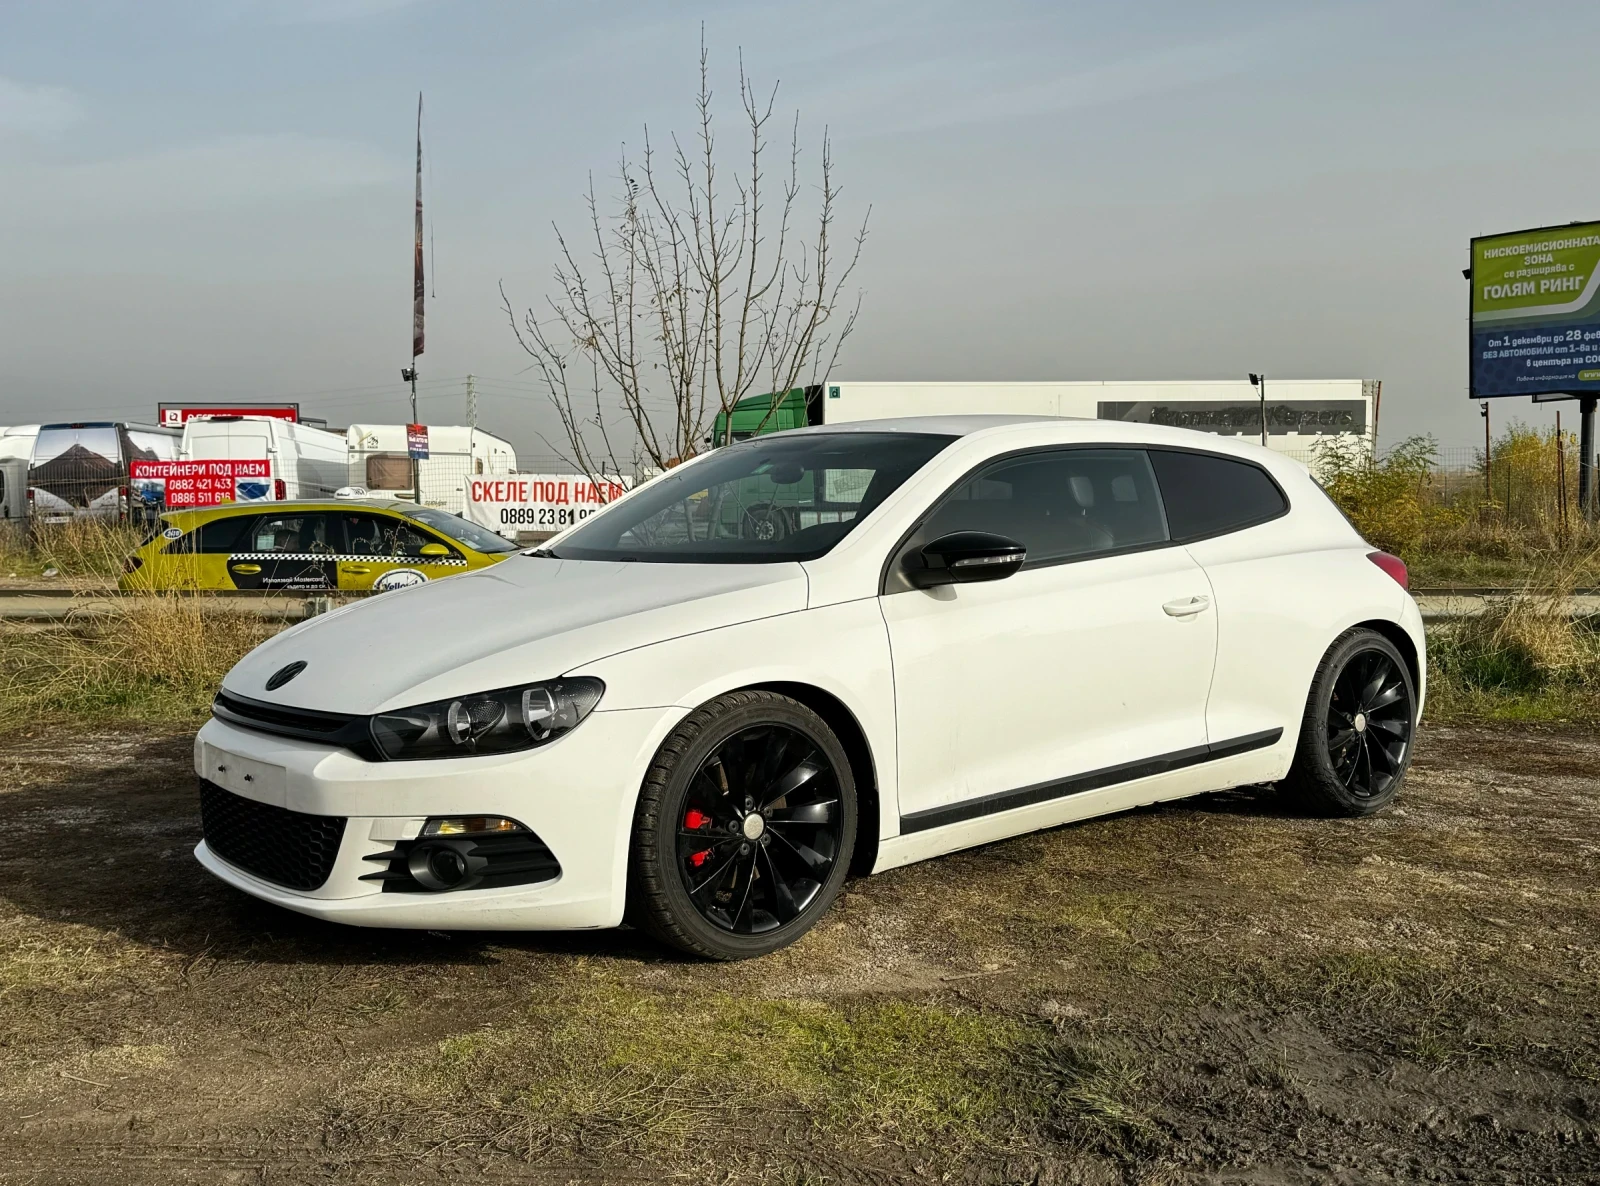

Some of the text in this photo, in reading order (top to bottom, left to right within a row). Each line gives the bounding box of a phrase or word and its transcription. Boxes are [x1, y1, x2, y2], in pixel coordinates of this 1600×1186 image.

[1484, 235, 1600, 259] НИСКОЕМИСИОННАТА
[1524, 253, 1553, 265] ЗОНА
[1516, 263, 1567, 279] разширява
[1484, 276, 1584, 299] ГОЛЯМ РИНГ
[1488, 339, 1502, 347] От
[1503, 335, 1510, 346] 1
[1512, 335, 1552, 347] декември
[1553, 335, 1564, 343] до
[1566, 330, 1582, 341] 28
[1483, 351, 1498, 359] БЕЗ
[1499, 346, 1554, 358] АВТОМОБИЛИ
[1526, 359, 1531, 367] в
[1533, 357, 1571, 367] центъра
[1573, 356, 1584, 364] на
[136, 463, 265, 477] КОНТЕЙНЕРИ ПОД НАЕМ
[169, 478, 231, 490] 0882 421 433
[171, 492, 195, 503] 0886
[198, 492, 212, 503] 511
[471, 481, 622, 505] СКЕЛЕ ПОД НАЕМ
[500, 508, 534, 524] 0889
[538, 509, 555, 524] 23
[559, 509, 575, 525] 81
